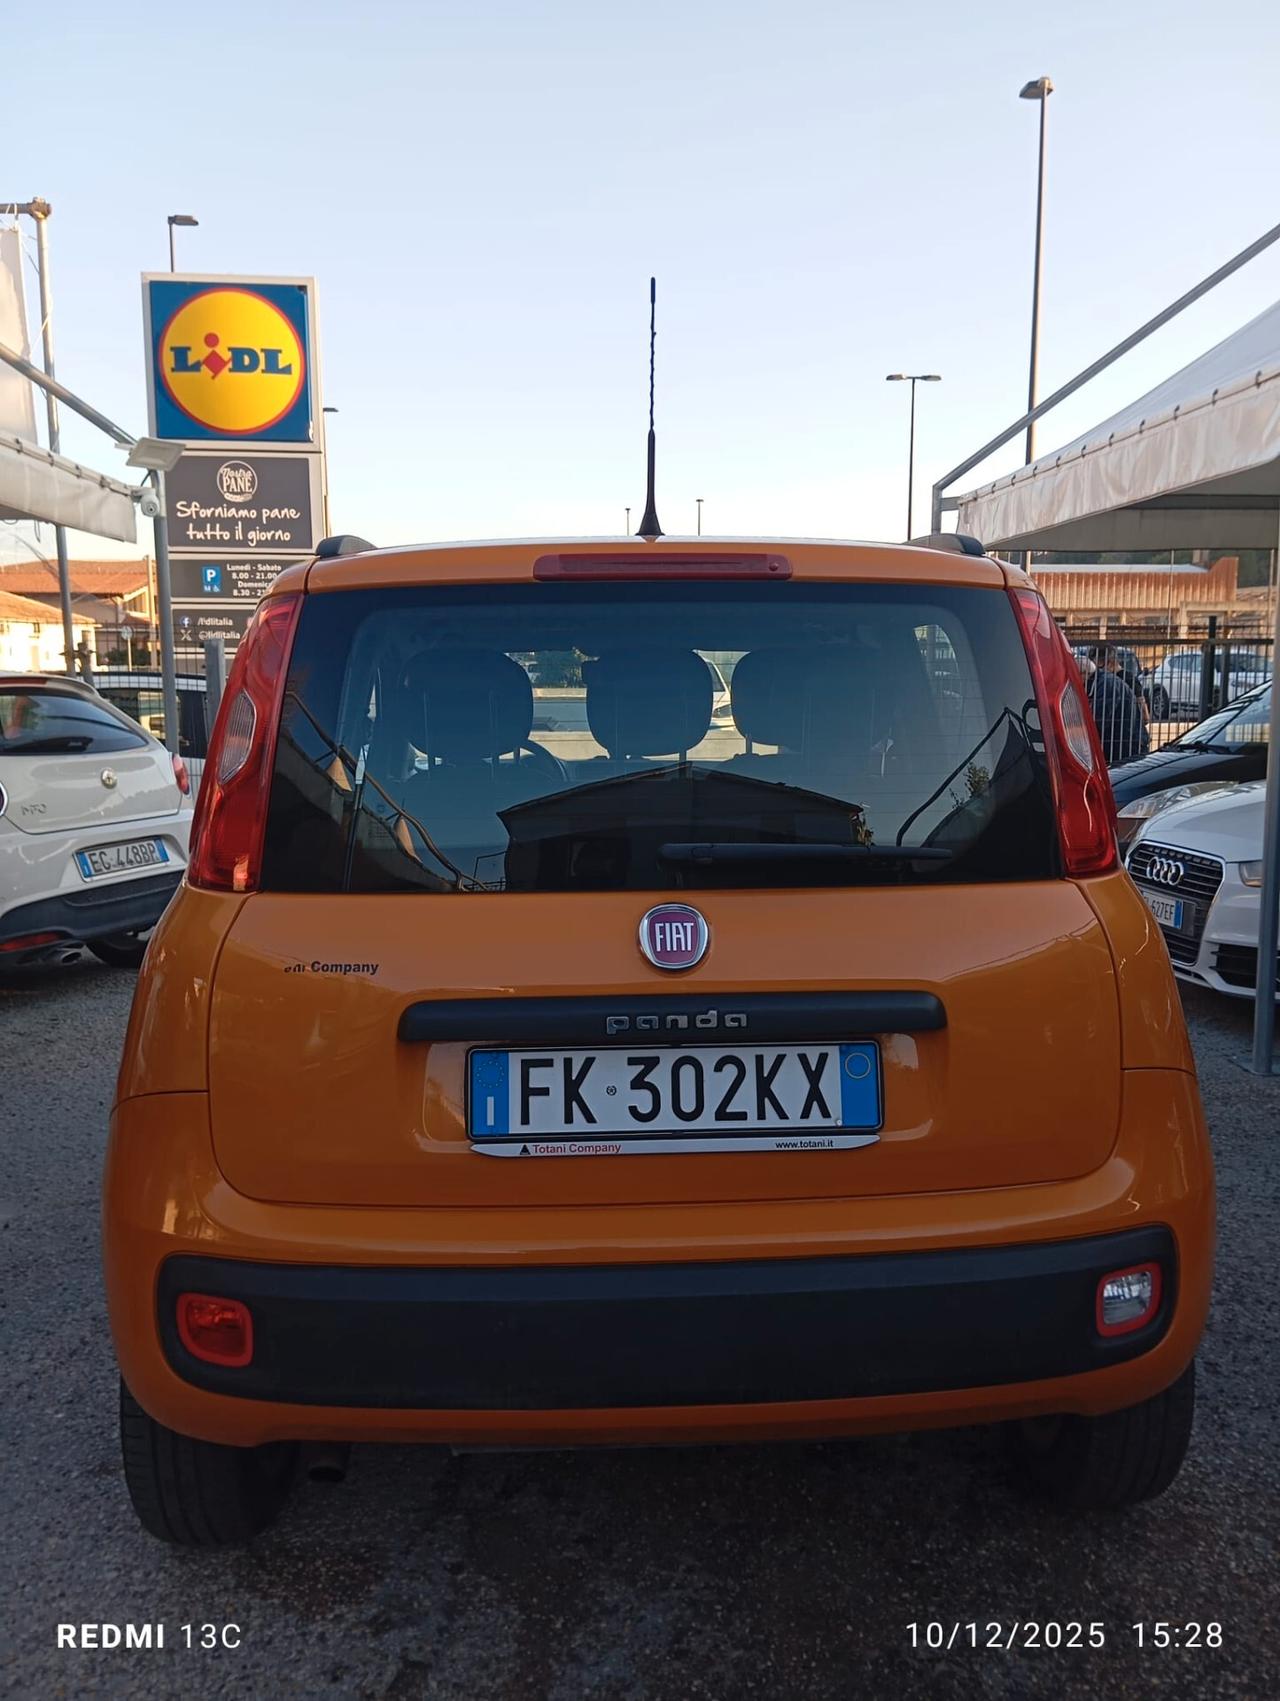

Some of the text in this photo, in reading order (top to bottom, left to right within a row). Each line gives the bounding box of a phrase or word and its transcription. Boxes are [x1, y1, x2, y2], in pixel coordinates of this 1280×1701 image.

[223, 477, 253, 492] PANE
[176, 501, 301, 524] Sforniamo pane
[186, 520, 291, 547] tutto il giorno
[654, 922, 694, 952] FIAT
[311, 960, 380, 976] Company
[606, 1010, 747, 1035] panda
[532, 1142, 622, 1155] Totani Company
[775, 1139, 834, 1149] www.totani.it
